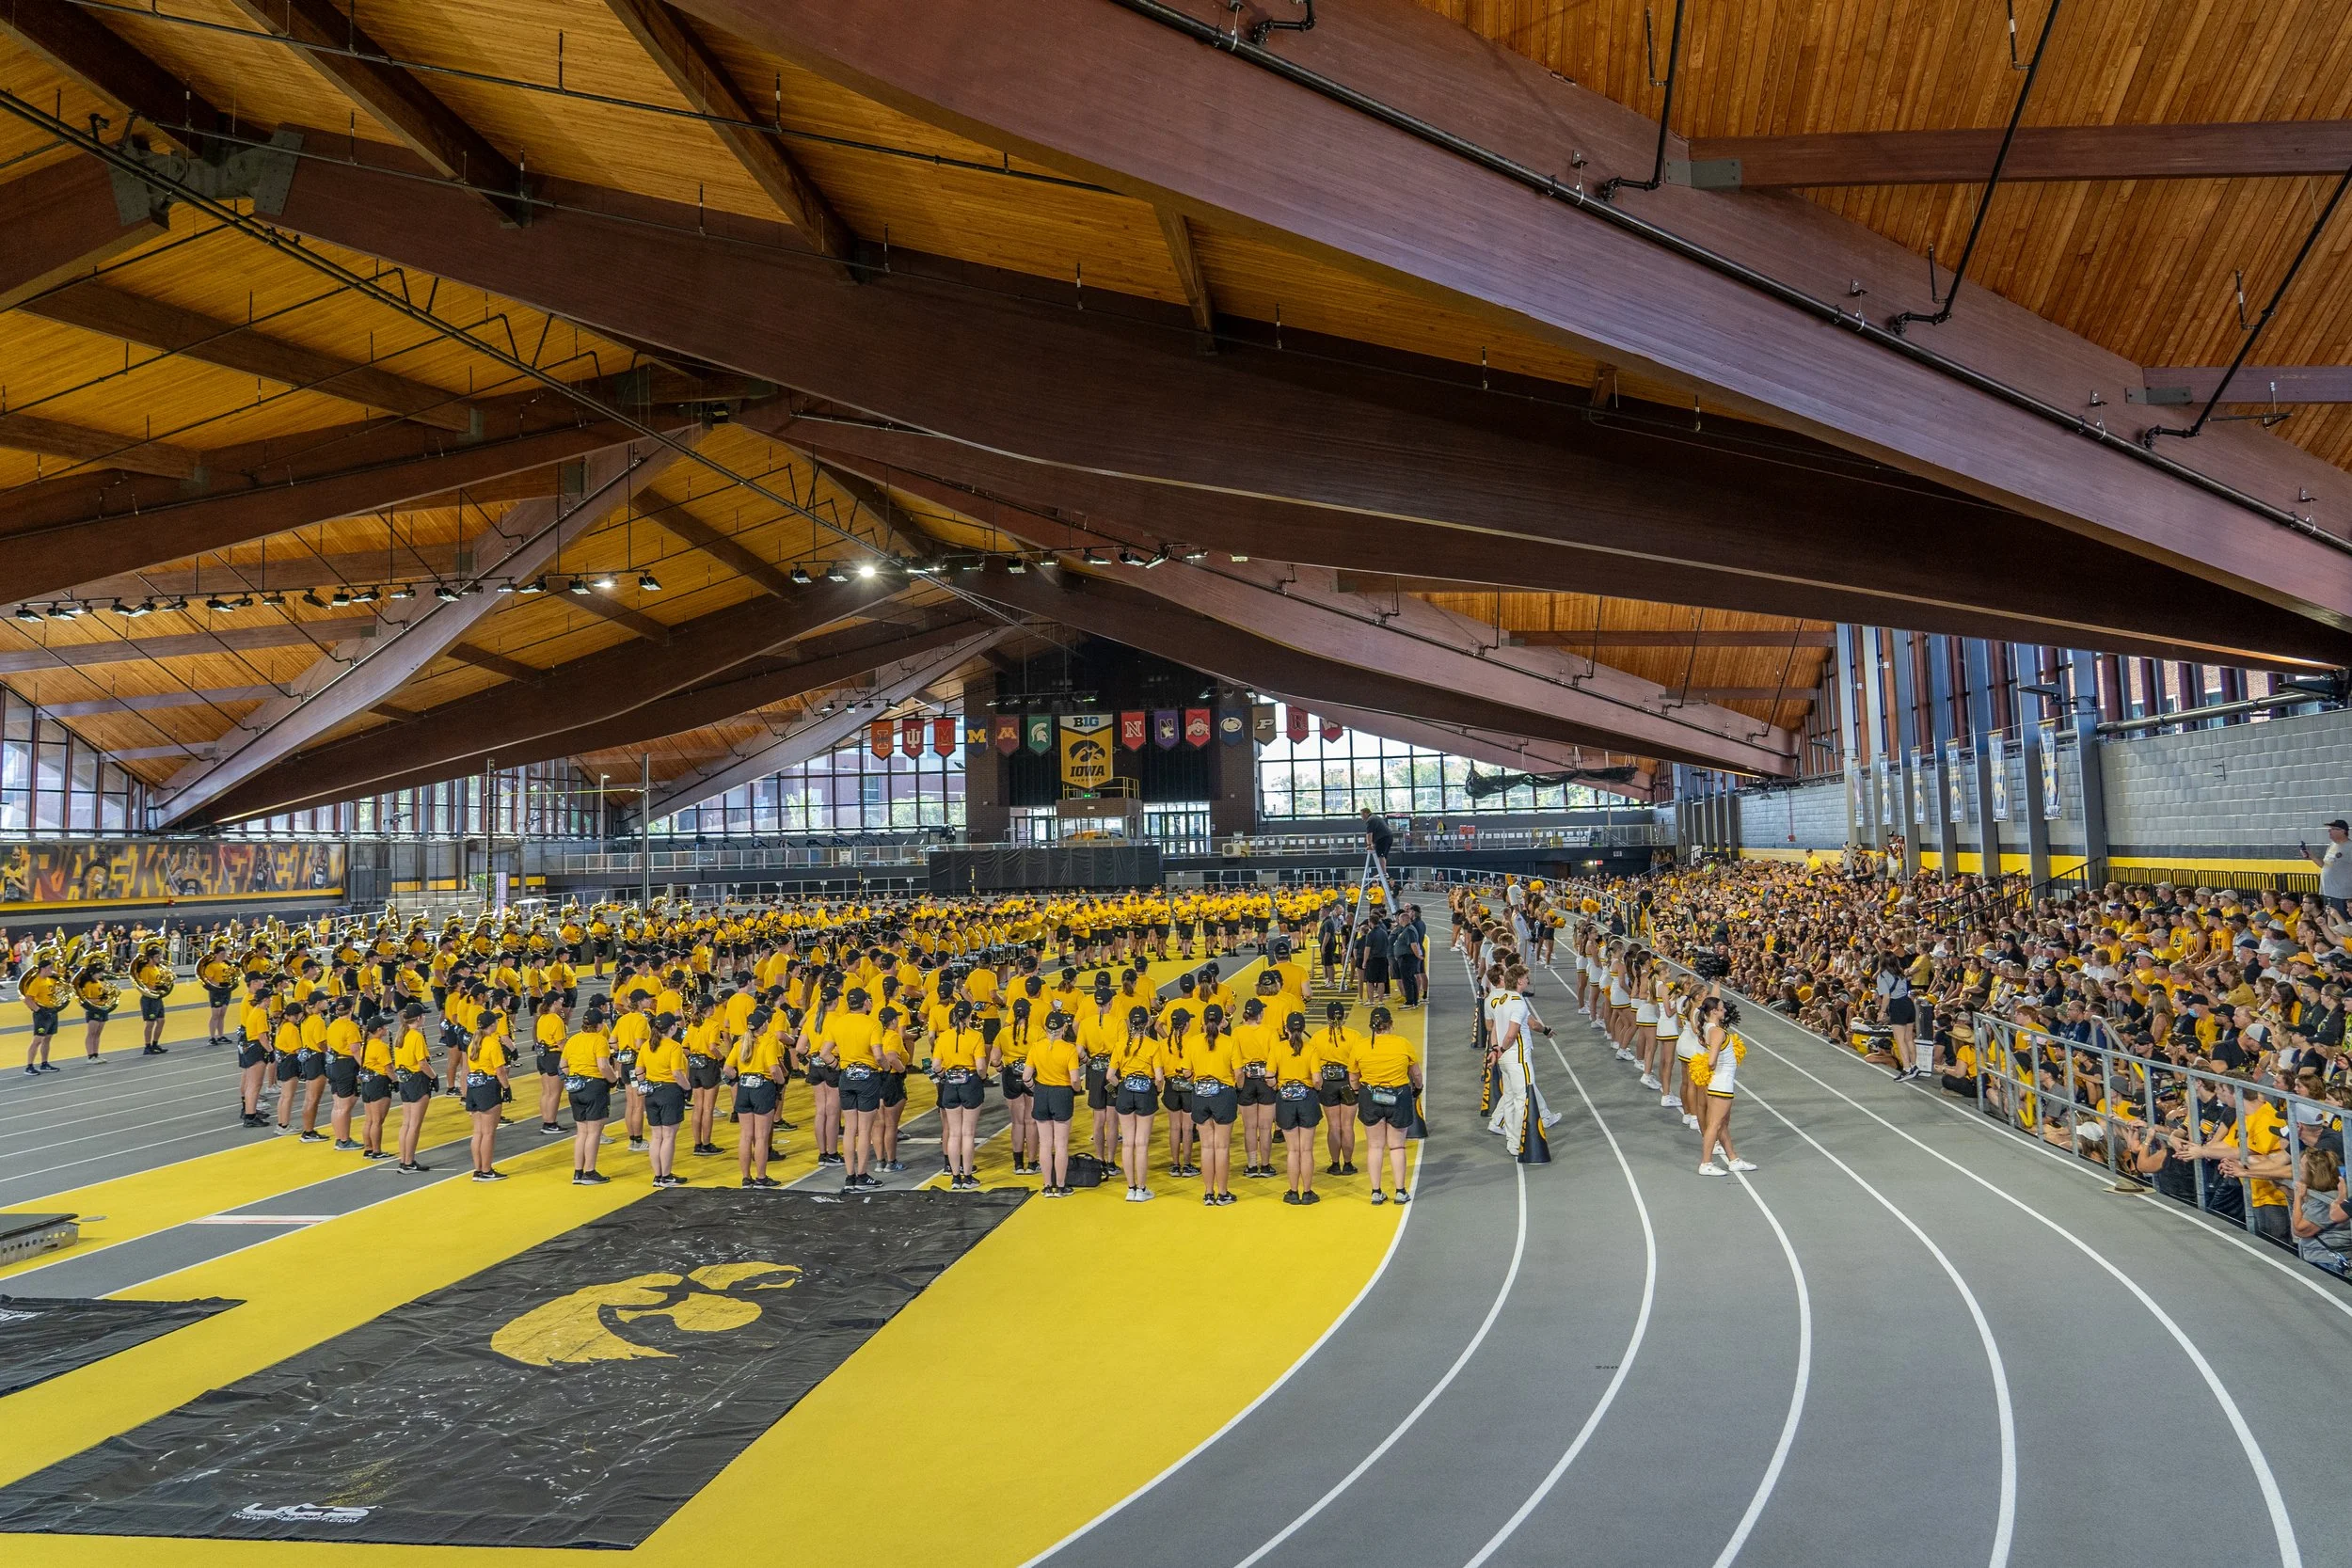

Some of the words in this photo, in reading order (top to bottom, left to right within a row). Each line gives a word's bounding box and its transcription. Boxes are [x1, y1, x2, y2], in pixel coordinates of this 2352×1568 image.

[1124, 721, 1142, 737] N
[1256, 719, 1275, 730] P
[967, 729, 986, 743] M
[1070, 766, 1104, 777] IOWA
